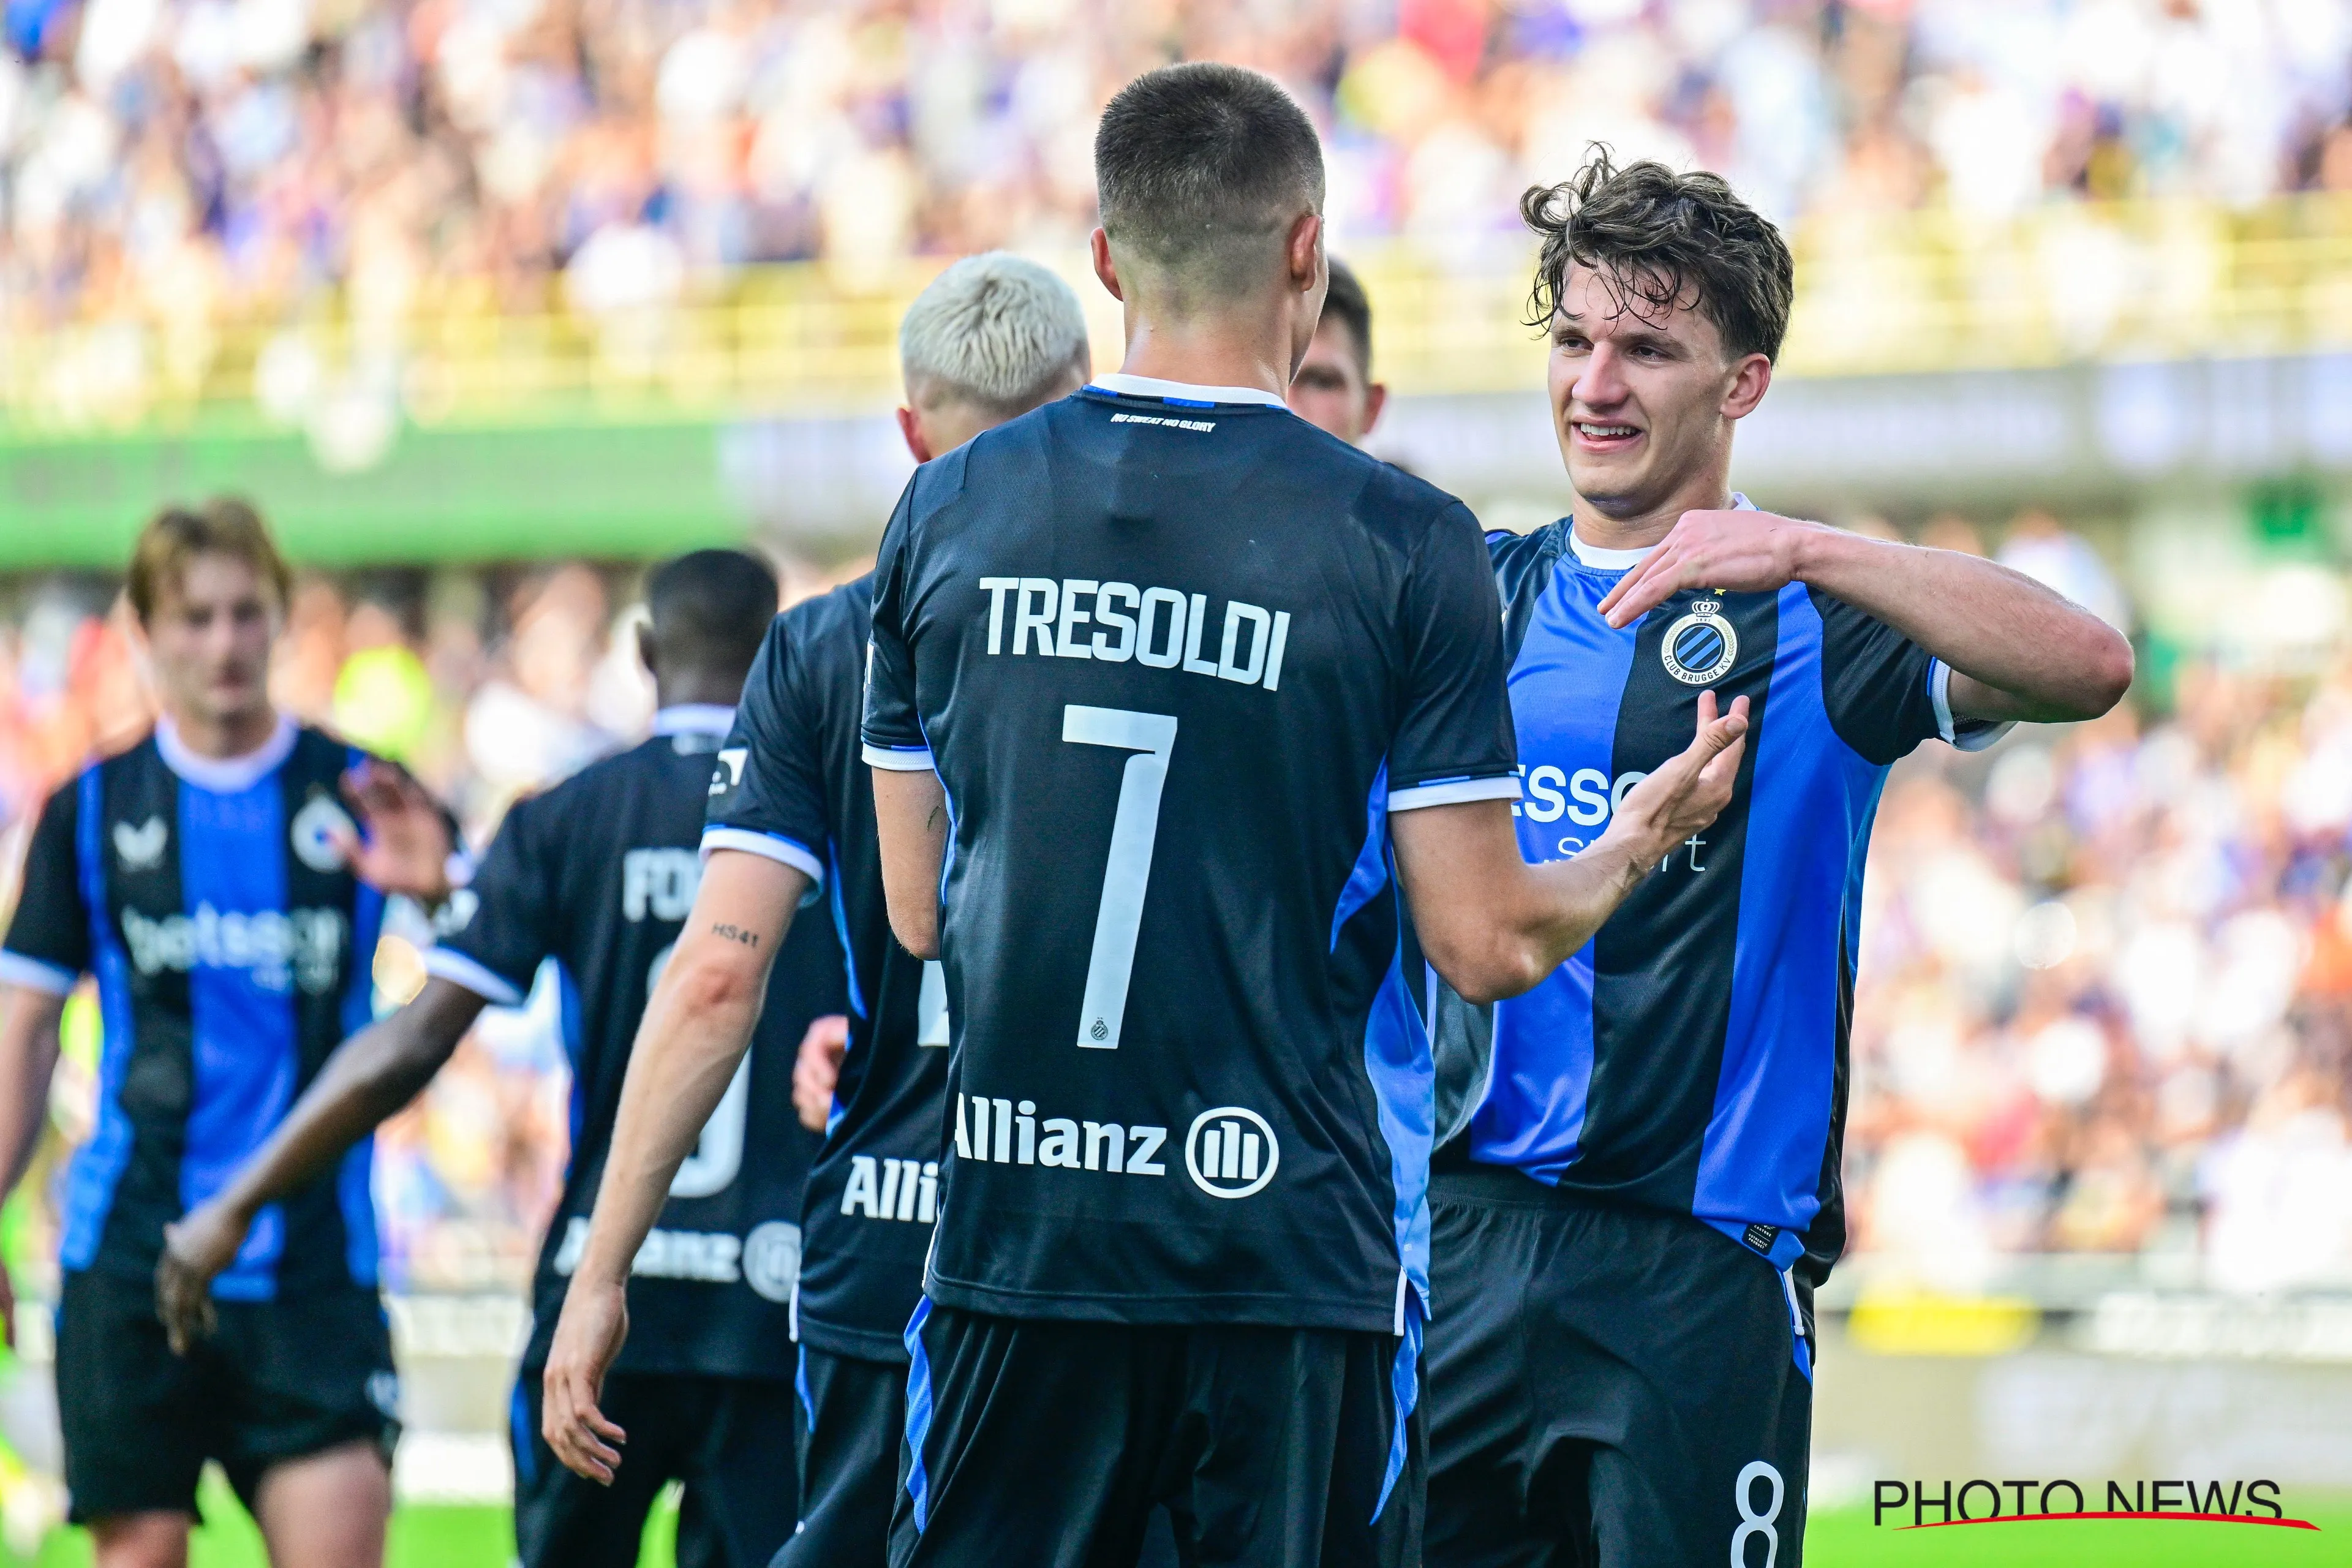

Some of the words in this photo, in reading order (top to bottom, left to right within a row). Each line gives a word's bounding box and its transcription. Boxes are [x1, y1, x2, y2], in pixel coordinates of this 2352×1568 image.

[1110, 413, 1129, 423] NO
[1126, 415, 1164, 425] SWEAT
[1162, 418, 1180, 428] NO
[1178, 420, 1216, 432] GLORY
[979, 577, 1291, 692] TRESOLDI
[1664, 655, 1681, 675] CLUB
[1681, 669, 1719, 682] BRUGGE
[1719, 657, 1731, 671] KV
[1062, 704, 1178, 1049] 7
[711, 922, 759, 948] HS41
[1748, 1233, 1768, 1247] AUTHENTIC
[1748, 1237, 1765, 1249] PRODUCT
[1754, 1224, 1772, 1237] CASTORE
[1730, 1460, 1785, 1568] 8
